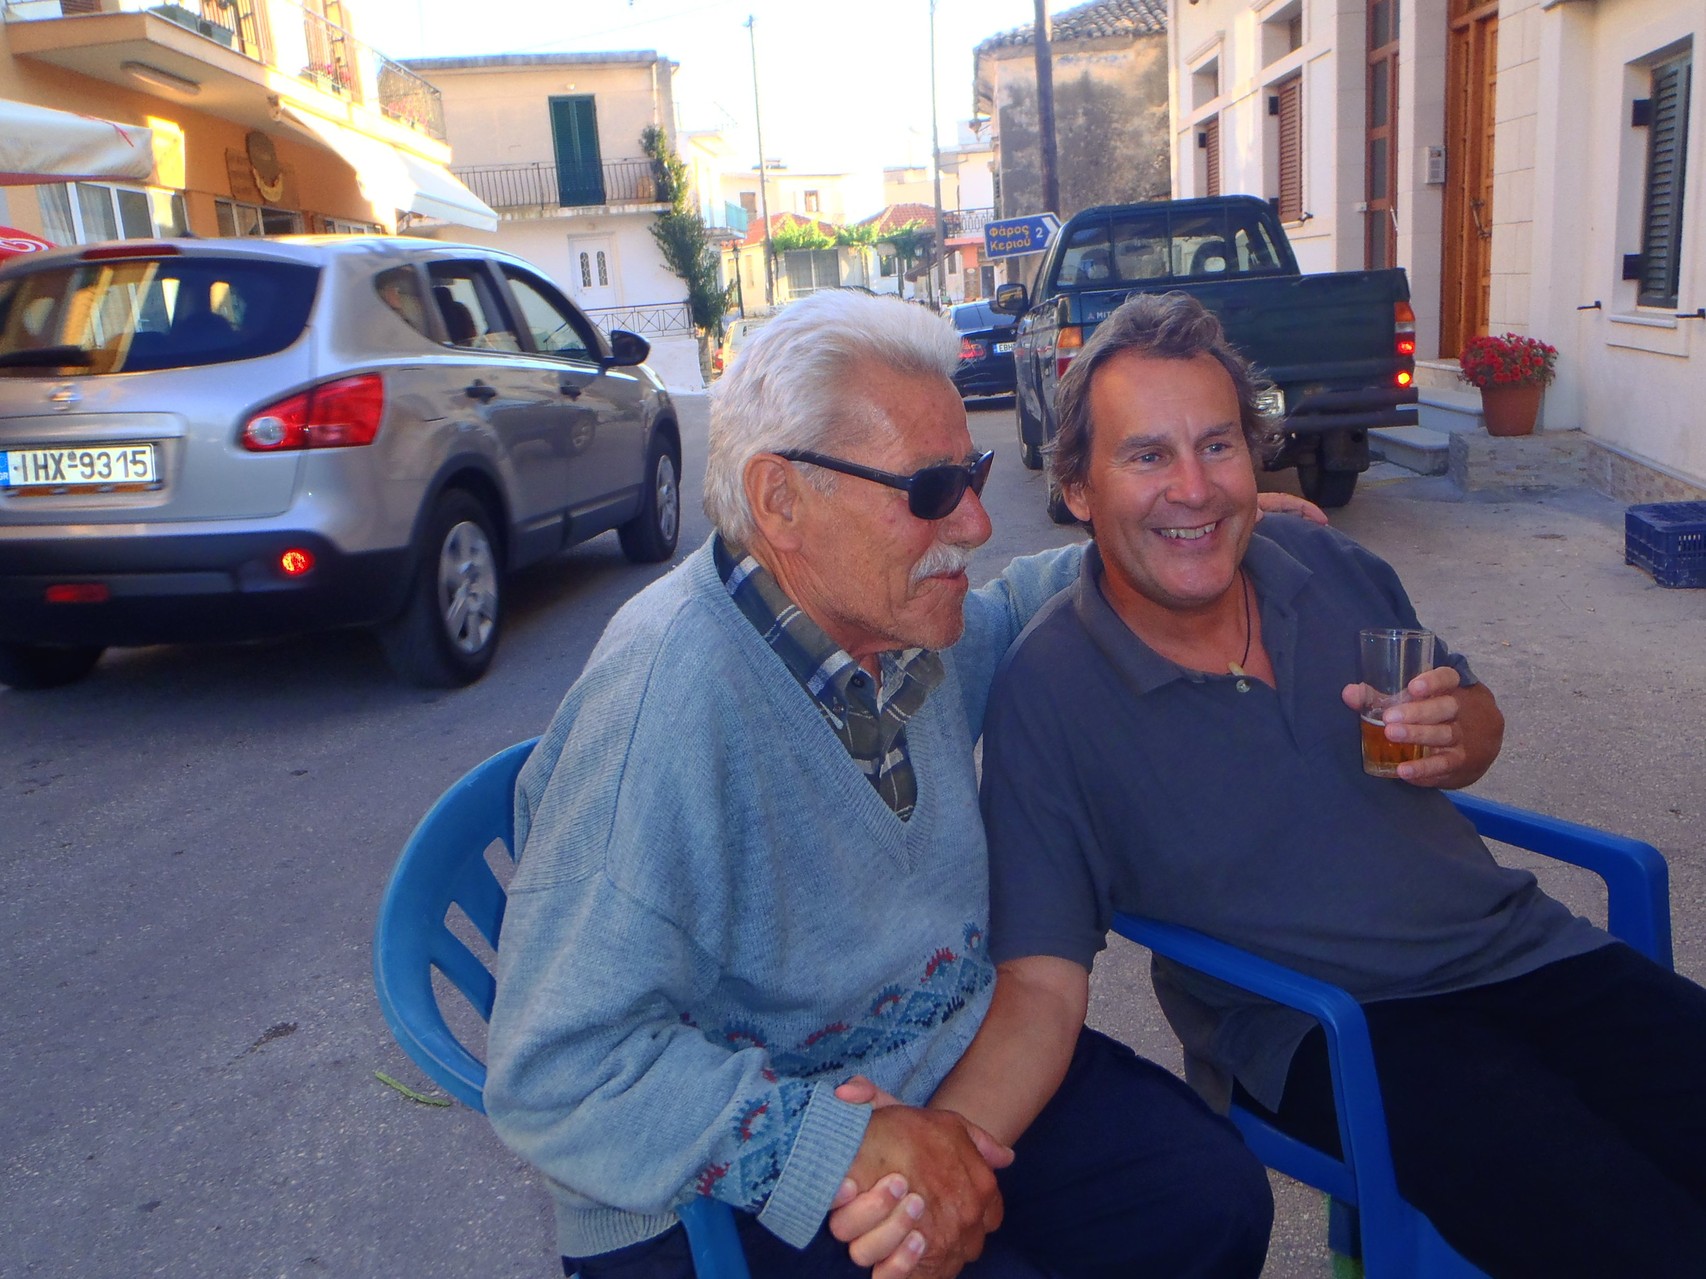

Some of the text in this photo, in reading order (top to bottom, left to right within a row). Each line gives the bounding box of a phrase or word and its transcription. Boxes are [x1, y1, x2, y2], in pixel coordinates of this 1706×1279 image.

[989, 225, 1029, 238] Φάρος
[1035, 227, 1044, 238] 2
[990, 236, 1031, 251] Κεριού
[1096, 311, 1111, 319] MIT
